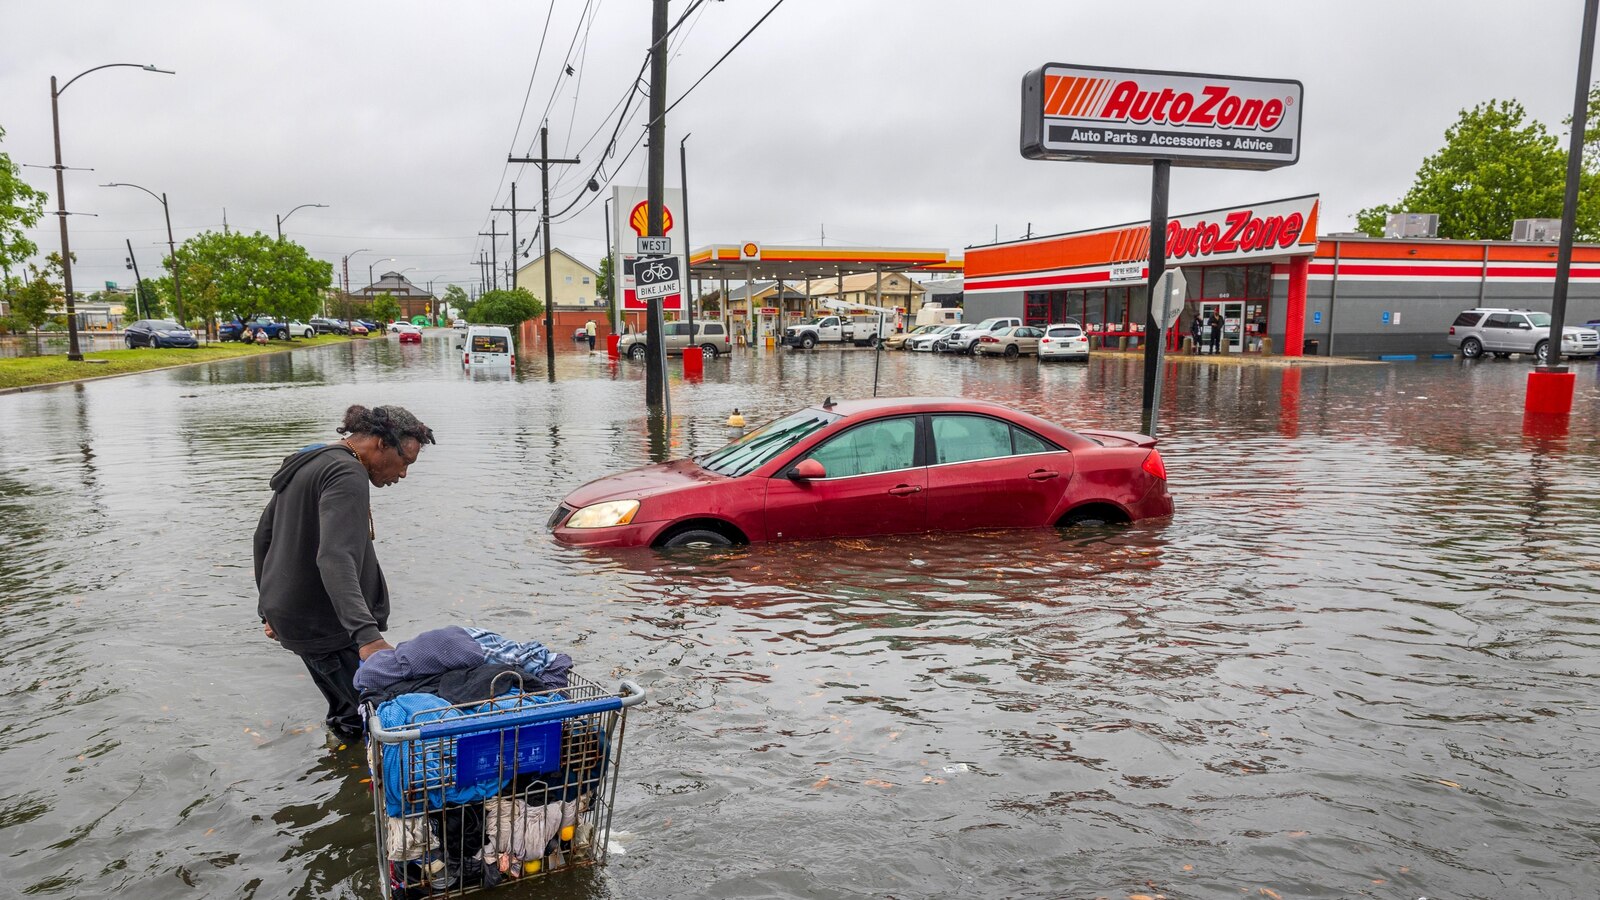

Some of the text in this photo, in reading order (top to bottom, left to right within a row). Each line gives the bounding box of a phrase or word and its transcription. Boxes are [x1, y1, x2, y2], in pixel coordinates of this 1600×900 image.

[1101, 80, 1284, 129] AutoZone
[1071, 130, 1273, 151] Auto Parts Accessories Advice
[642, 240, 667, 251] WEST
[641, 283, 676, 295] BIKE LANE
